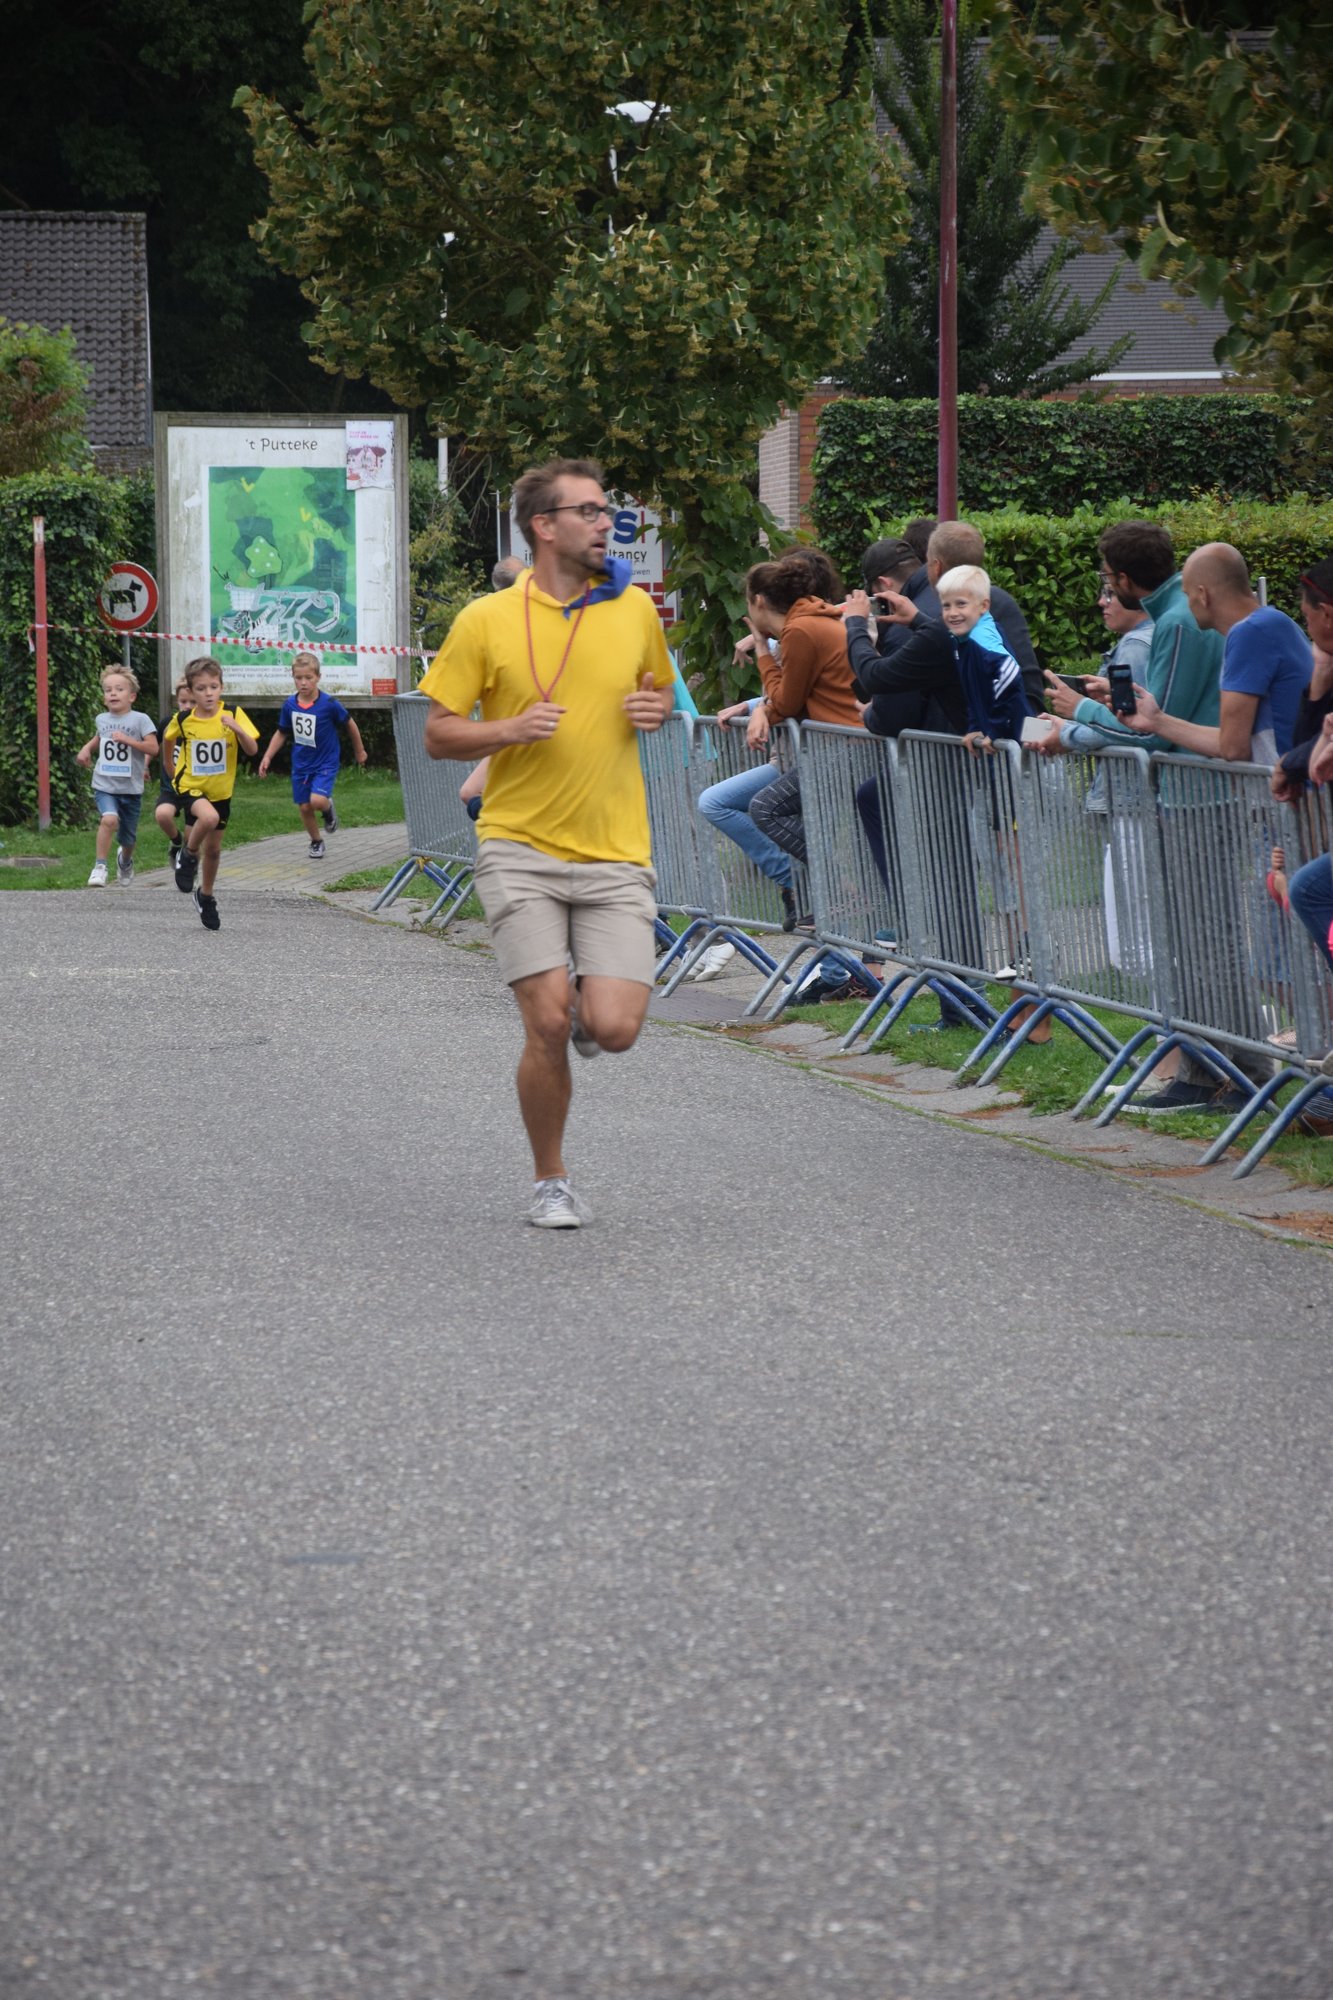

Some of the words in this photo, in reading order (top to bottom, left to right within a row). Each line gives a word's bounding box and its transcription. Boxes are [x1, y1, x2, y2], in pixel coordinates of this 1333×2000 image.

[260, 437, 319, 453] Putteke
[604, 548, 648, 564] ltancy
[295, 716, 313, 737] 53
[104, 740, 129, 762] 68
[195, 741, 224, 764] 60
